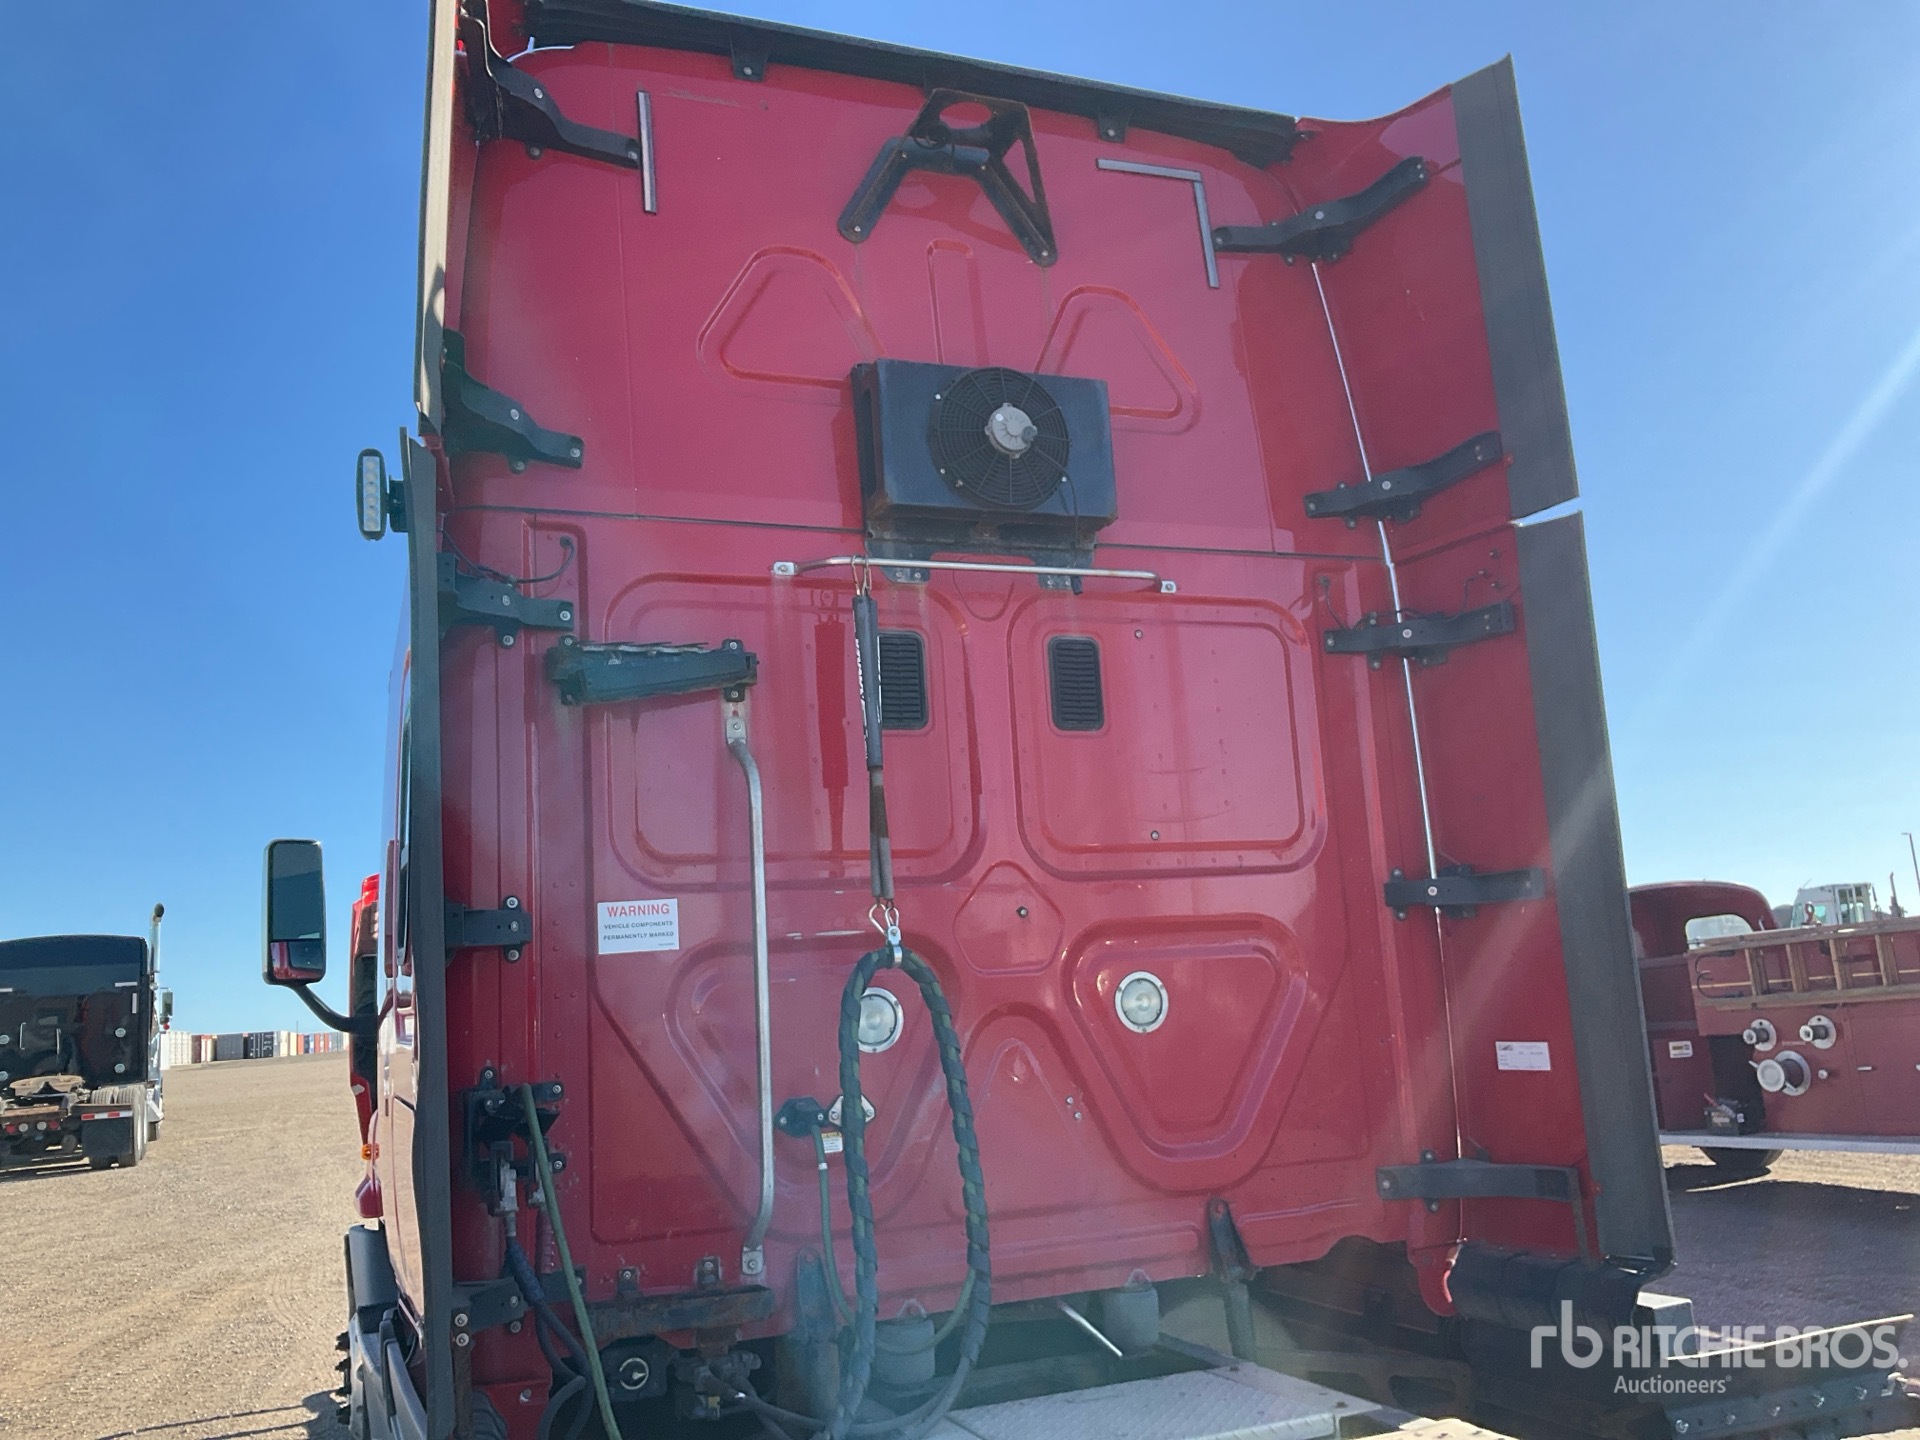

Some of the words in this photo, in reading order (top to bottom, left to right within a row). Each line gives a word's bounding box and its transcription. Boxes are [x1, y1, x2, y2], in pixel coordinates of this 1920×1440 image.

[607, 903, 670, 917] WARNING
[631, 920, 673, 928] COMPONENTS
[603, 932, 647, 940] PERMANENTLY
